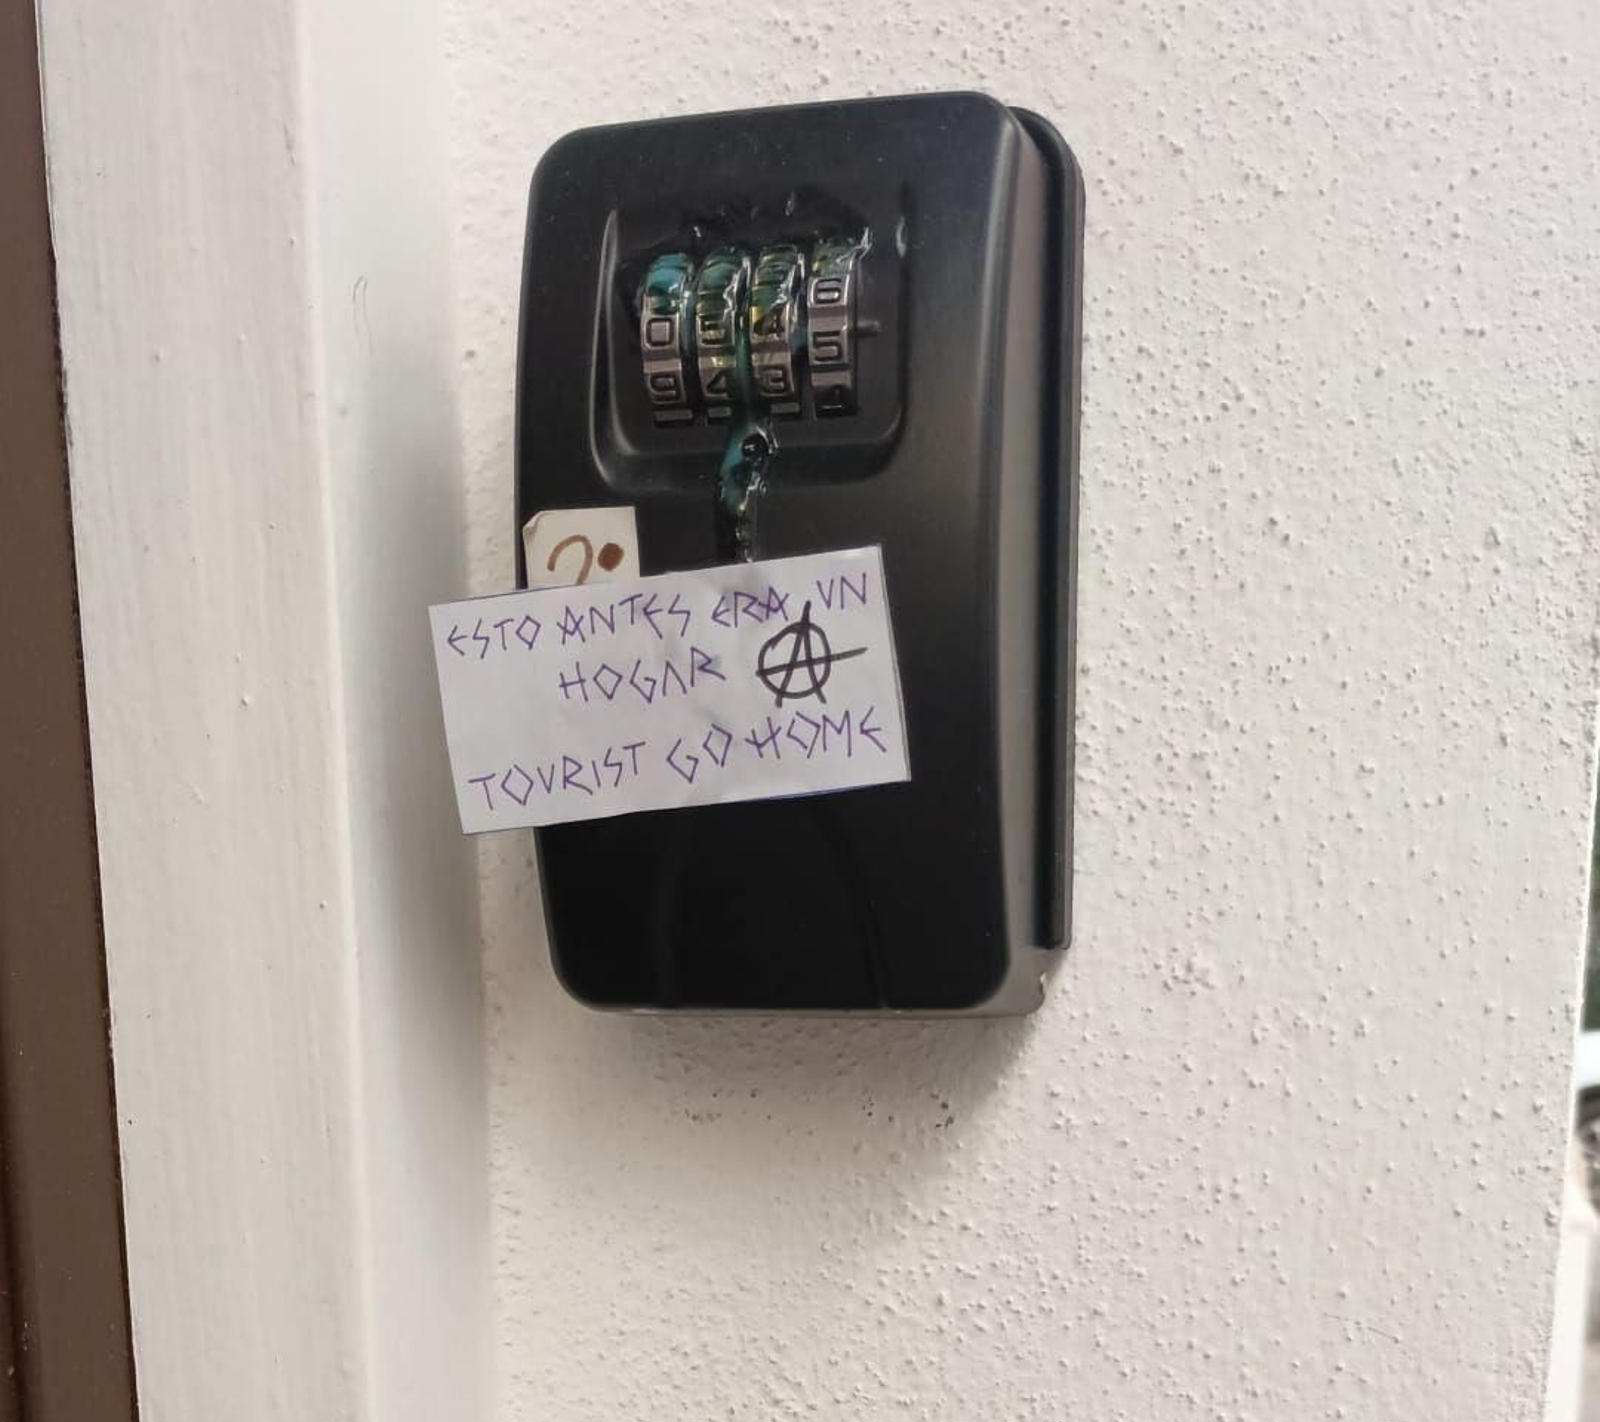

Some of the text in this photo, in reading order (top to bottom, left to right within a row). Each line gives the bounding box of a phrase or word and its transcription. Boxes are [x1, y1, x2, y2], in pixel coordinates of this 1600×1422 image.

[447, 616, 542, 659] ESTO
[557, 592, 691, 645] ANTES
[711, 586, 789, 629] ERA
[559, 646, 726, 704] HOGAR
[666, 723, 733, 784] GO
[745, 706, 888, 760] HOME
